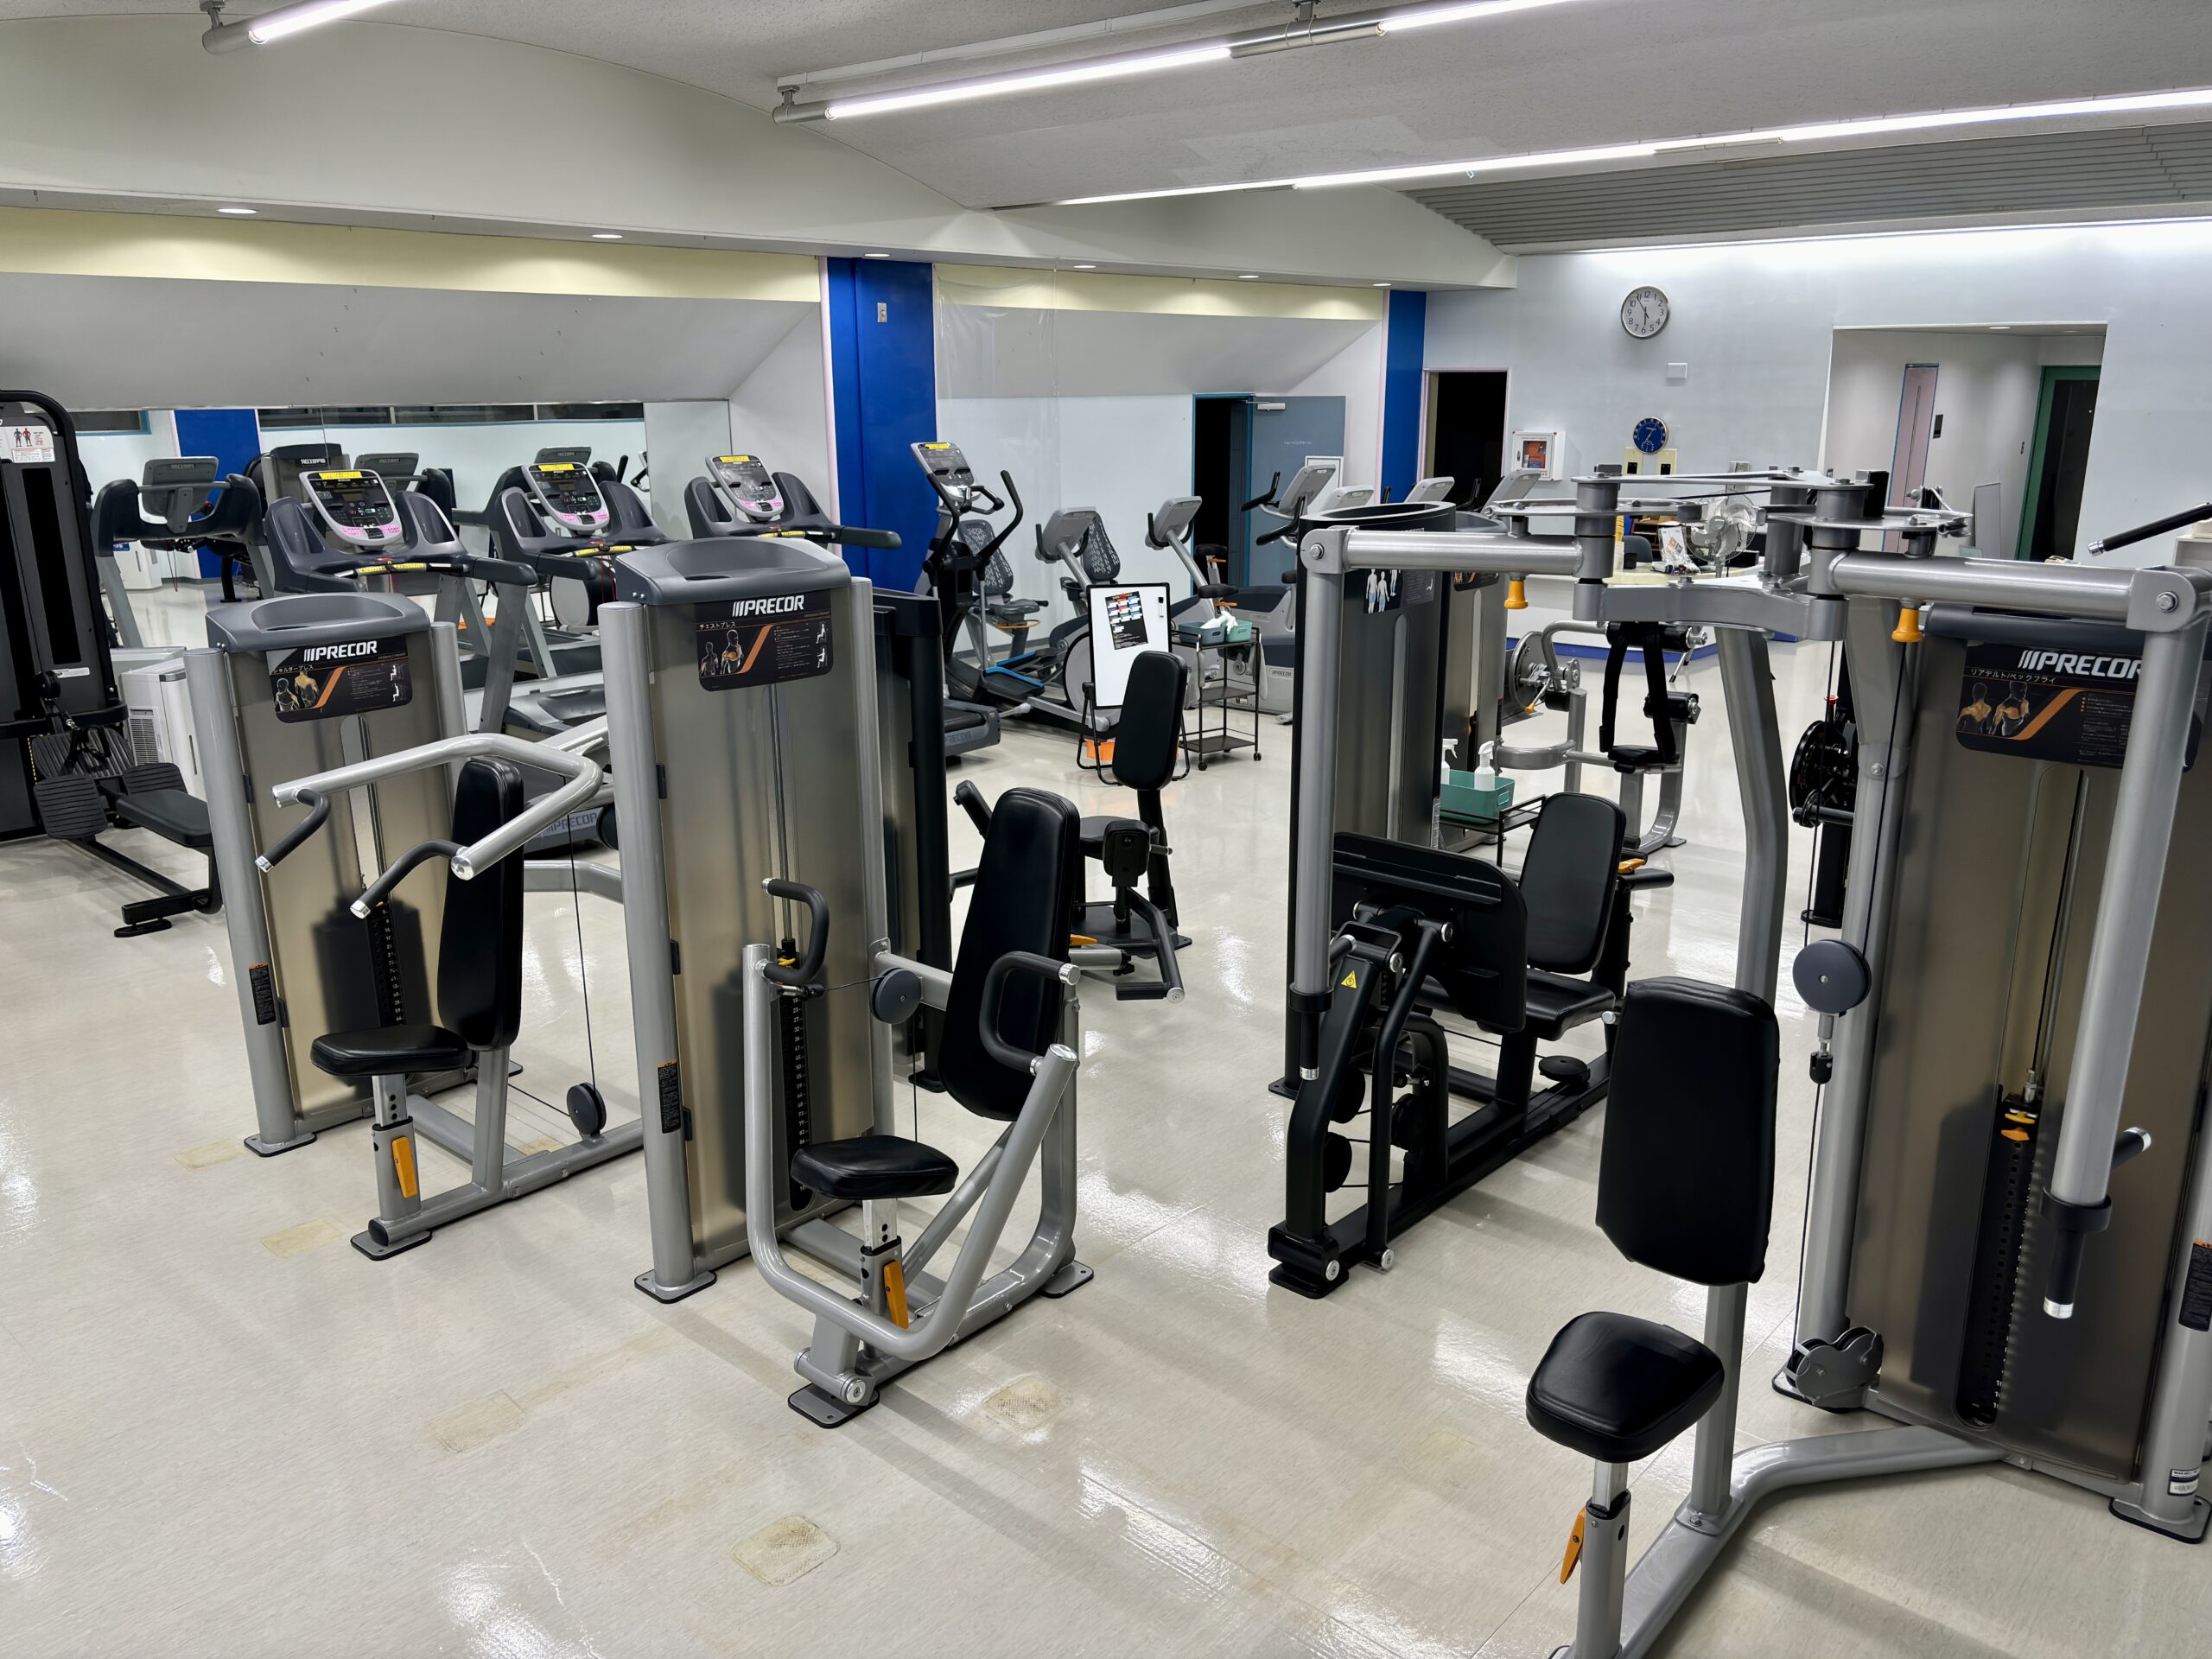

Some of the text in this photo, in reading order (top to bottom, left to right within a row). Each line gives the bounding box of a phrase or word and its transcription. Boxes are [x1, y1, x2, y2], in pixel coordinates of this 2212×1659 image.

[744, 595, 804, 616] PRECOR
[699, 621, 736, 630] チェストプレス
[315, 640, 378, 661] PRECOR
